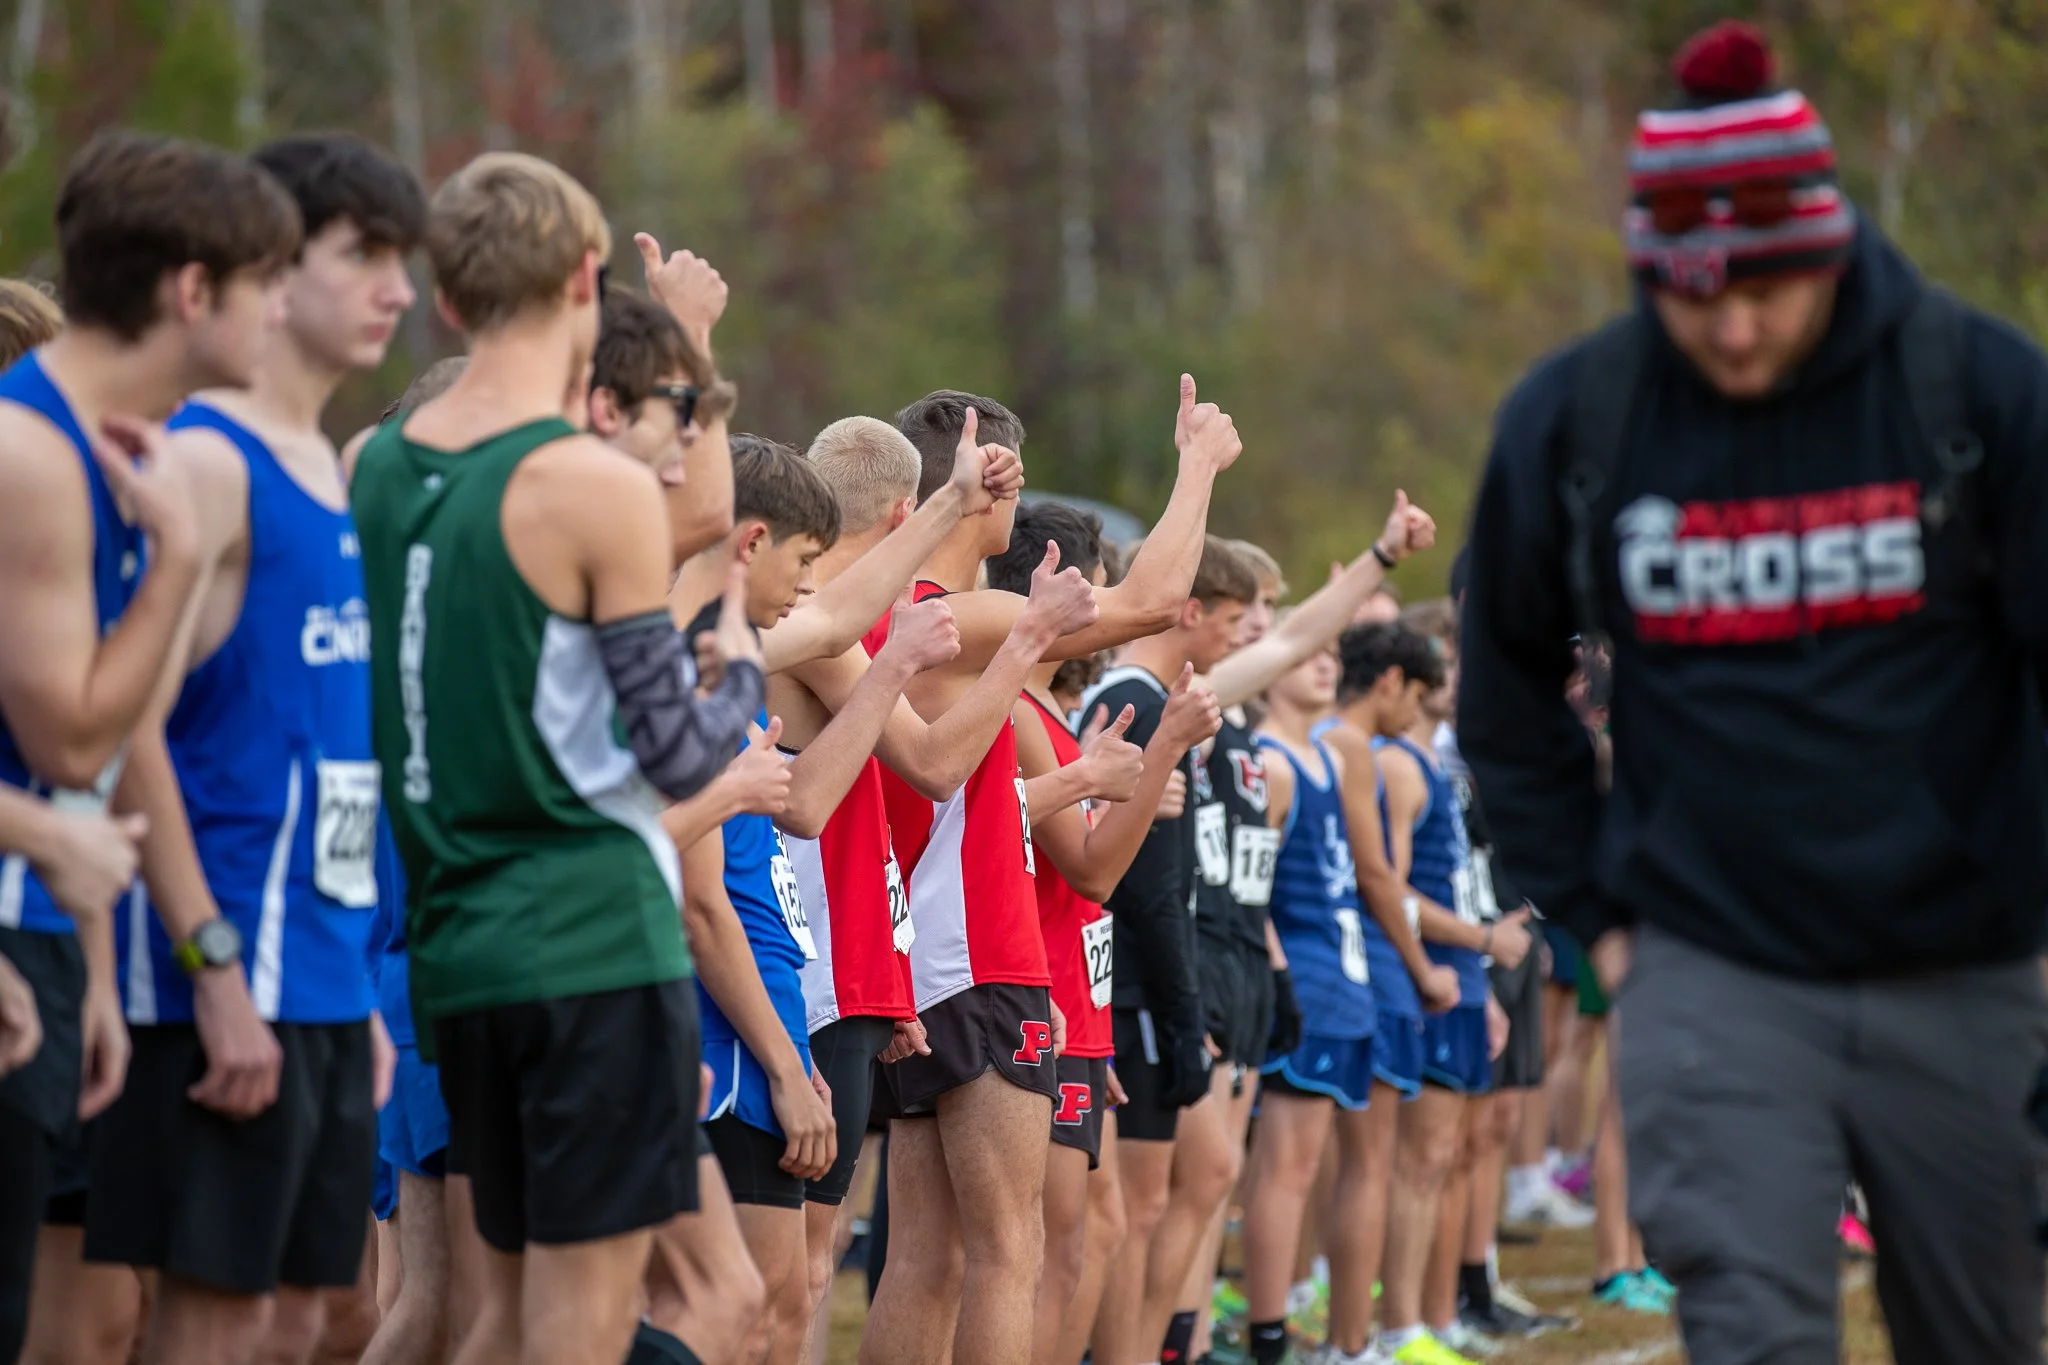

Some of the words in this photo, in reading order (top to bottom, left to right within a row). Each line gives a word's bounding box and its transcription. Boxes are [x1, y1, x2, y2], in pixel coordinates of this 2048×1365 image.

[1619, 516, 1925, 615] CROSS
[1013, 1021, 1052, 1066] P
[1054, 1083, 1092, 1125] P
